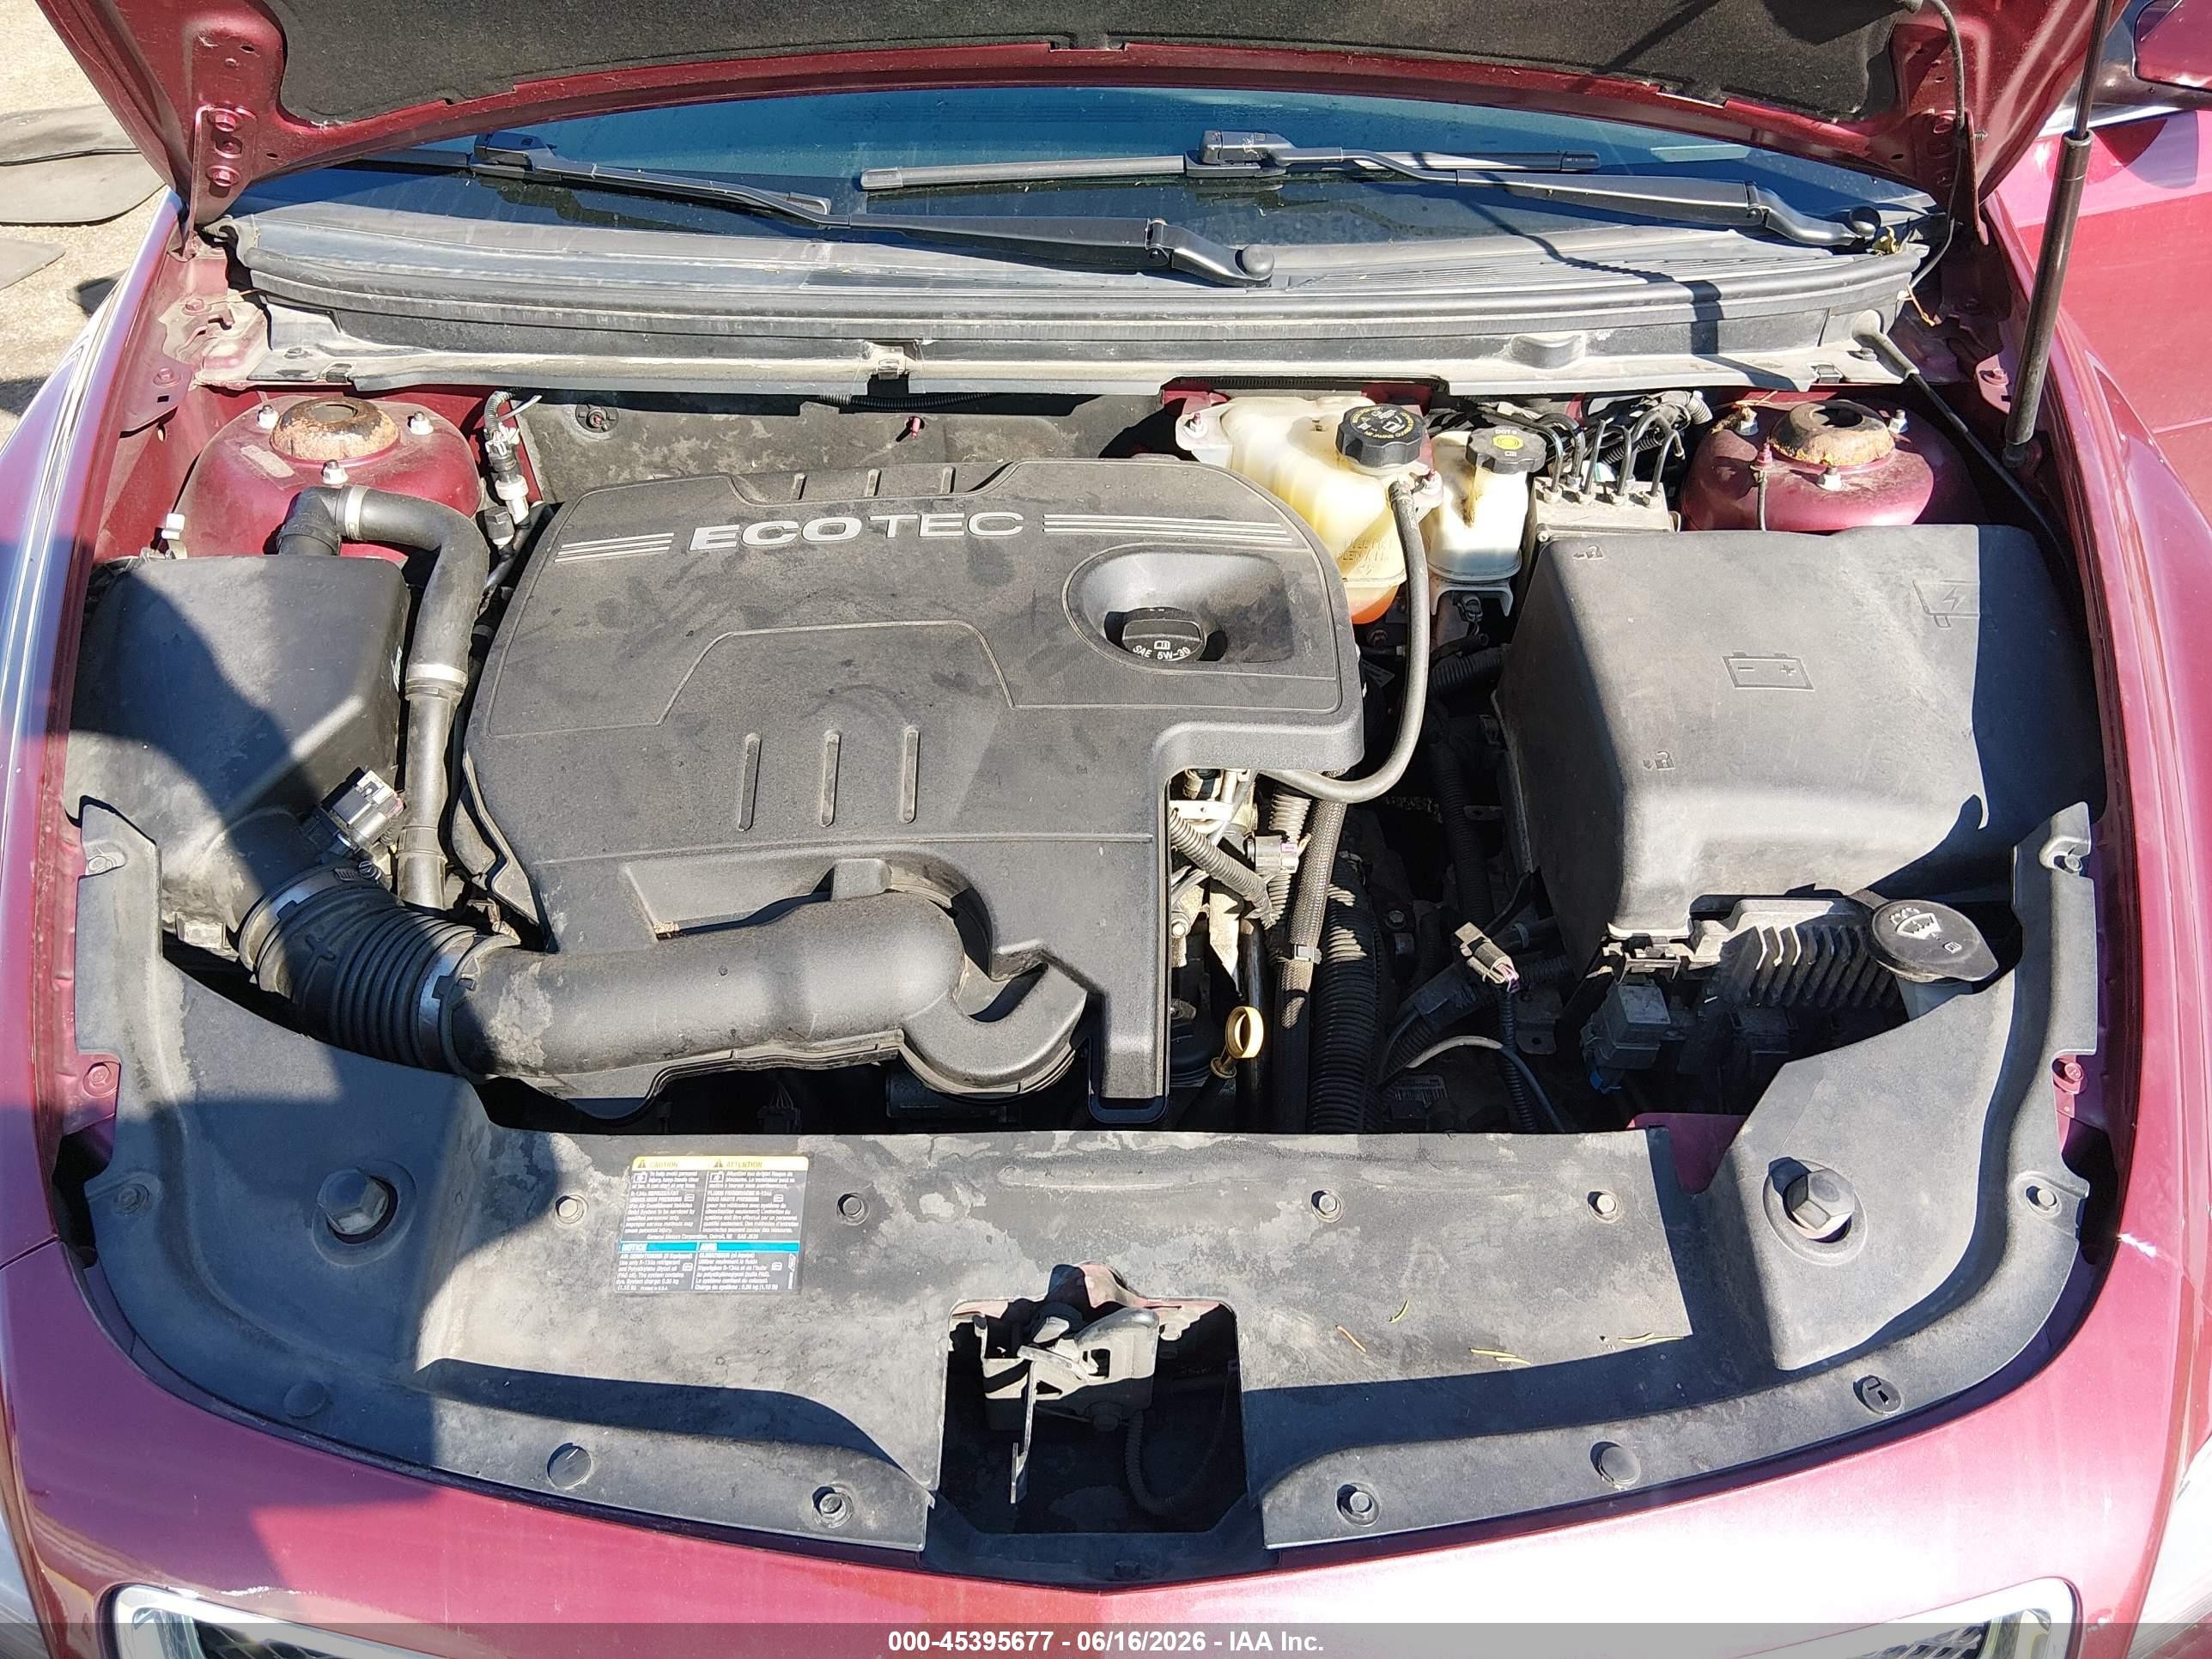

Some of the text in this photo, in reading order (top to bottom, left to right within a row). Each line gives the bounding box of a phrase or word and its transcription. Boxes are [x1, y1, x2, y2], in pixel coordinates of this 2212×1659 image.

[689, 512, 1024, 551] ECOTEC
[1133, 645, 1191, 660] SAE 5W-30
